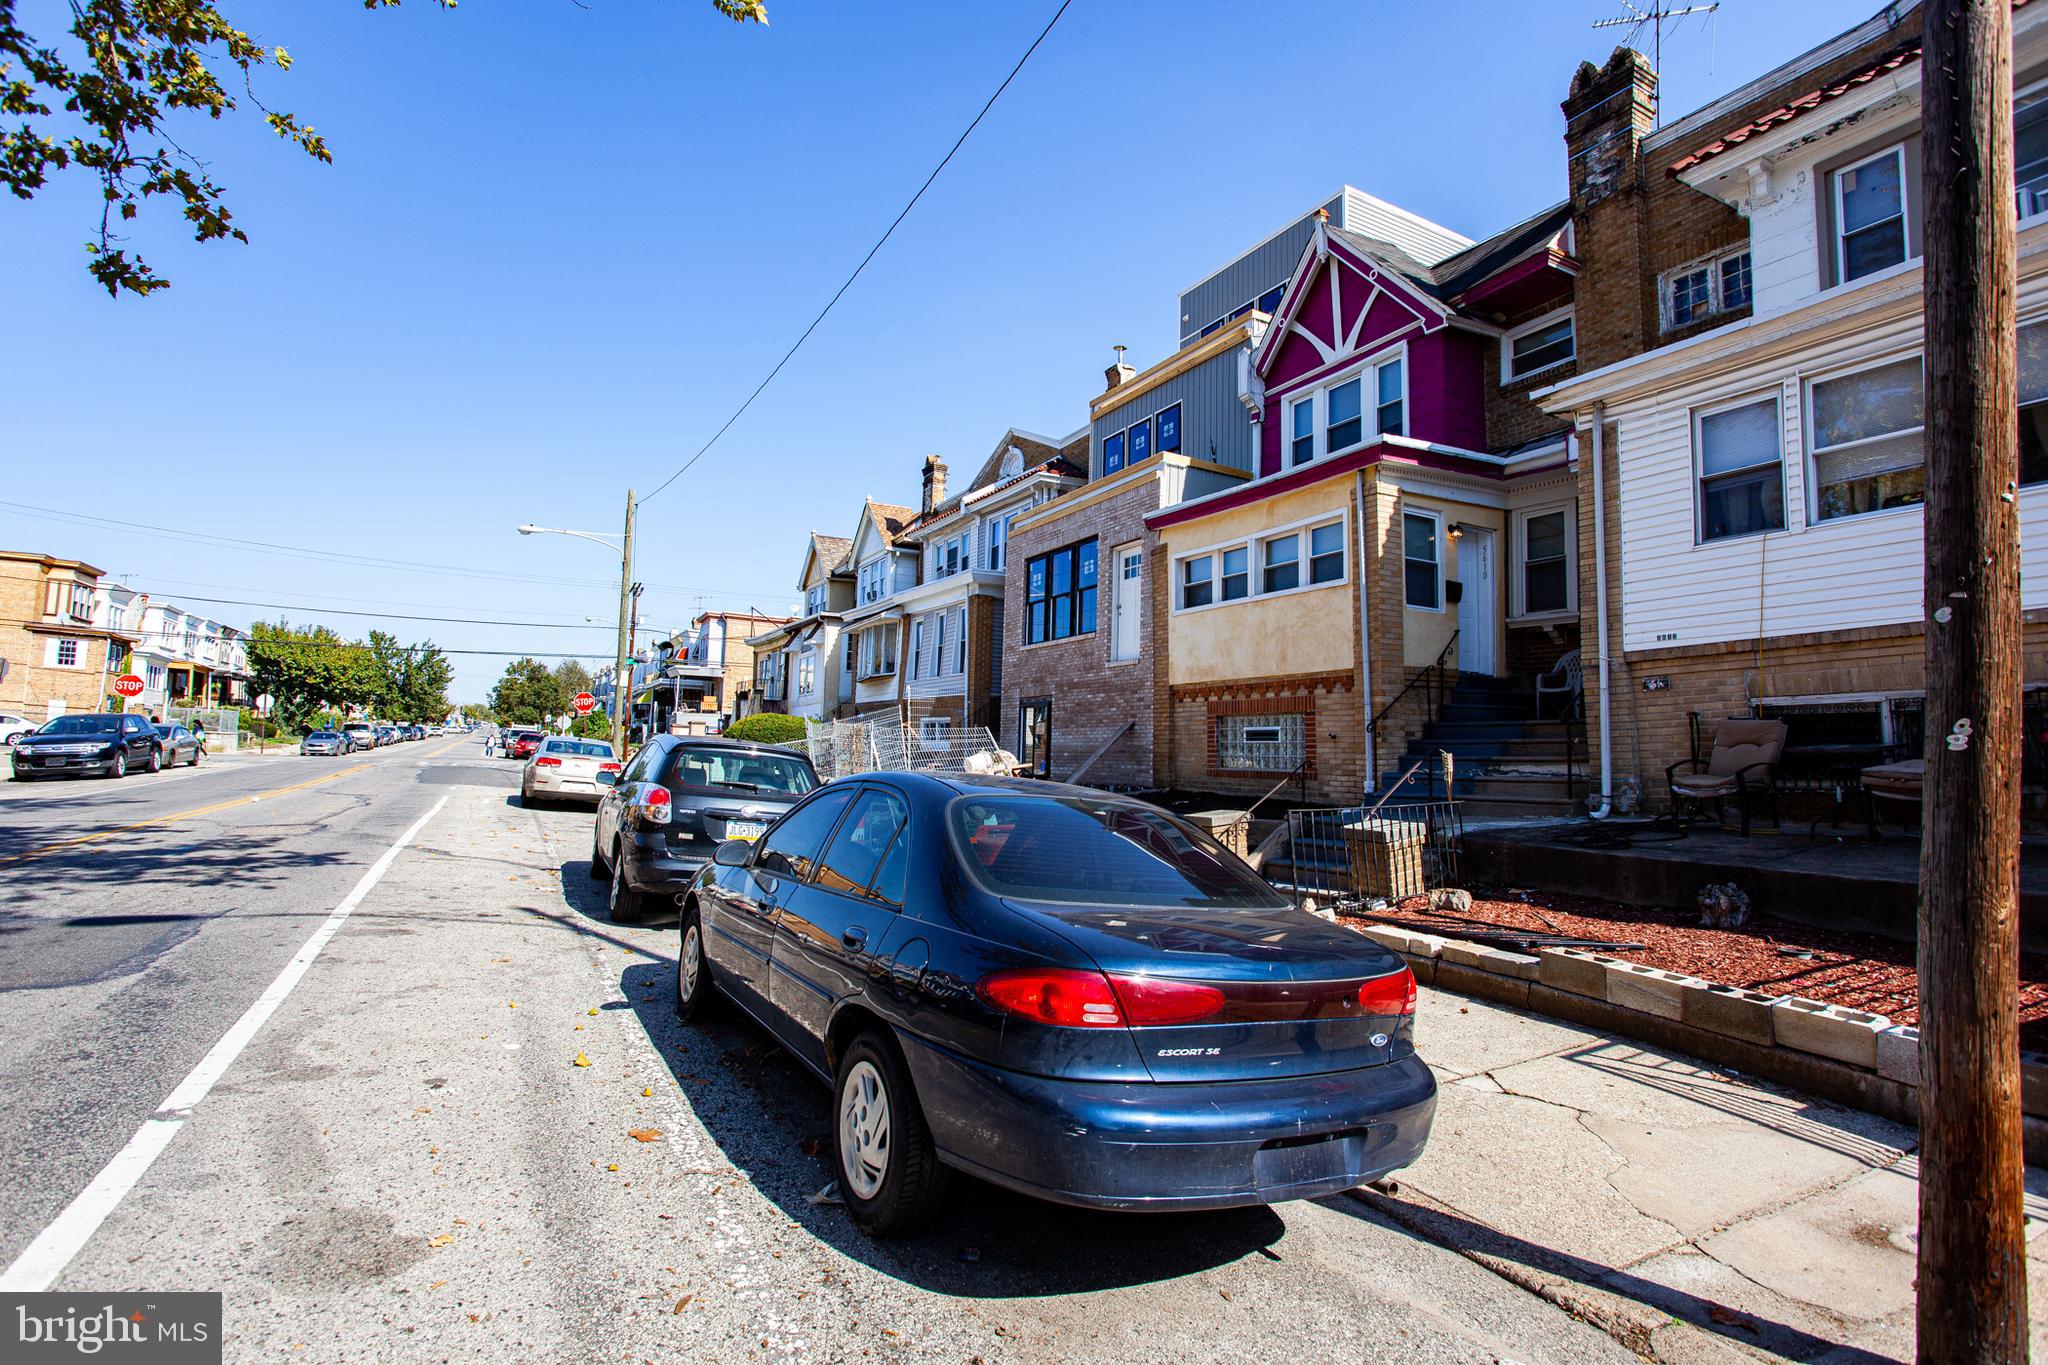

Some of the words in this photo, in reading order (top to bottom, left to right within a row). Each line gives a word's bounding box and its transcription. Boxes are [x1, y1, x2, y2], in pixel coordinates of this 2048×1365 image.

[116, 680, 143, 691] STOP
[575, 697, 594, 706] STOP
[1157, 1048, 1205, 1057] ESCORT
[1205, 1047, 1221, 1055] SE
